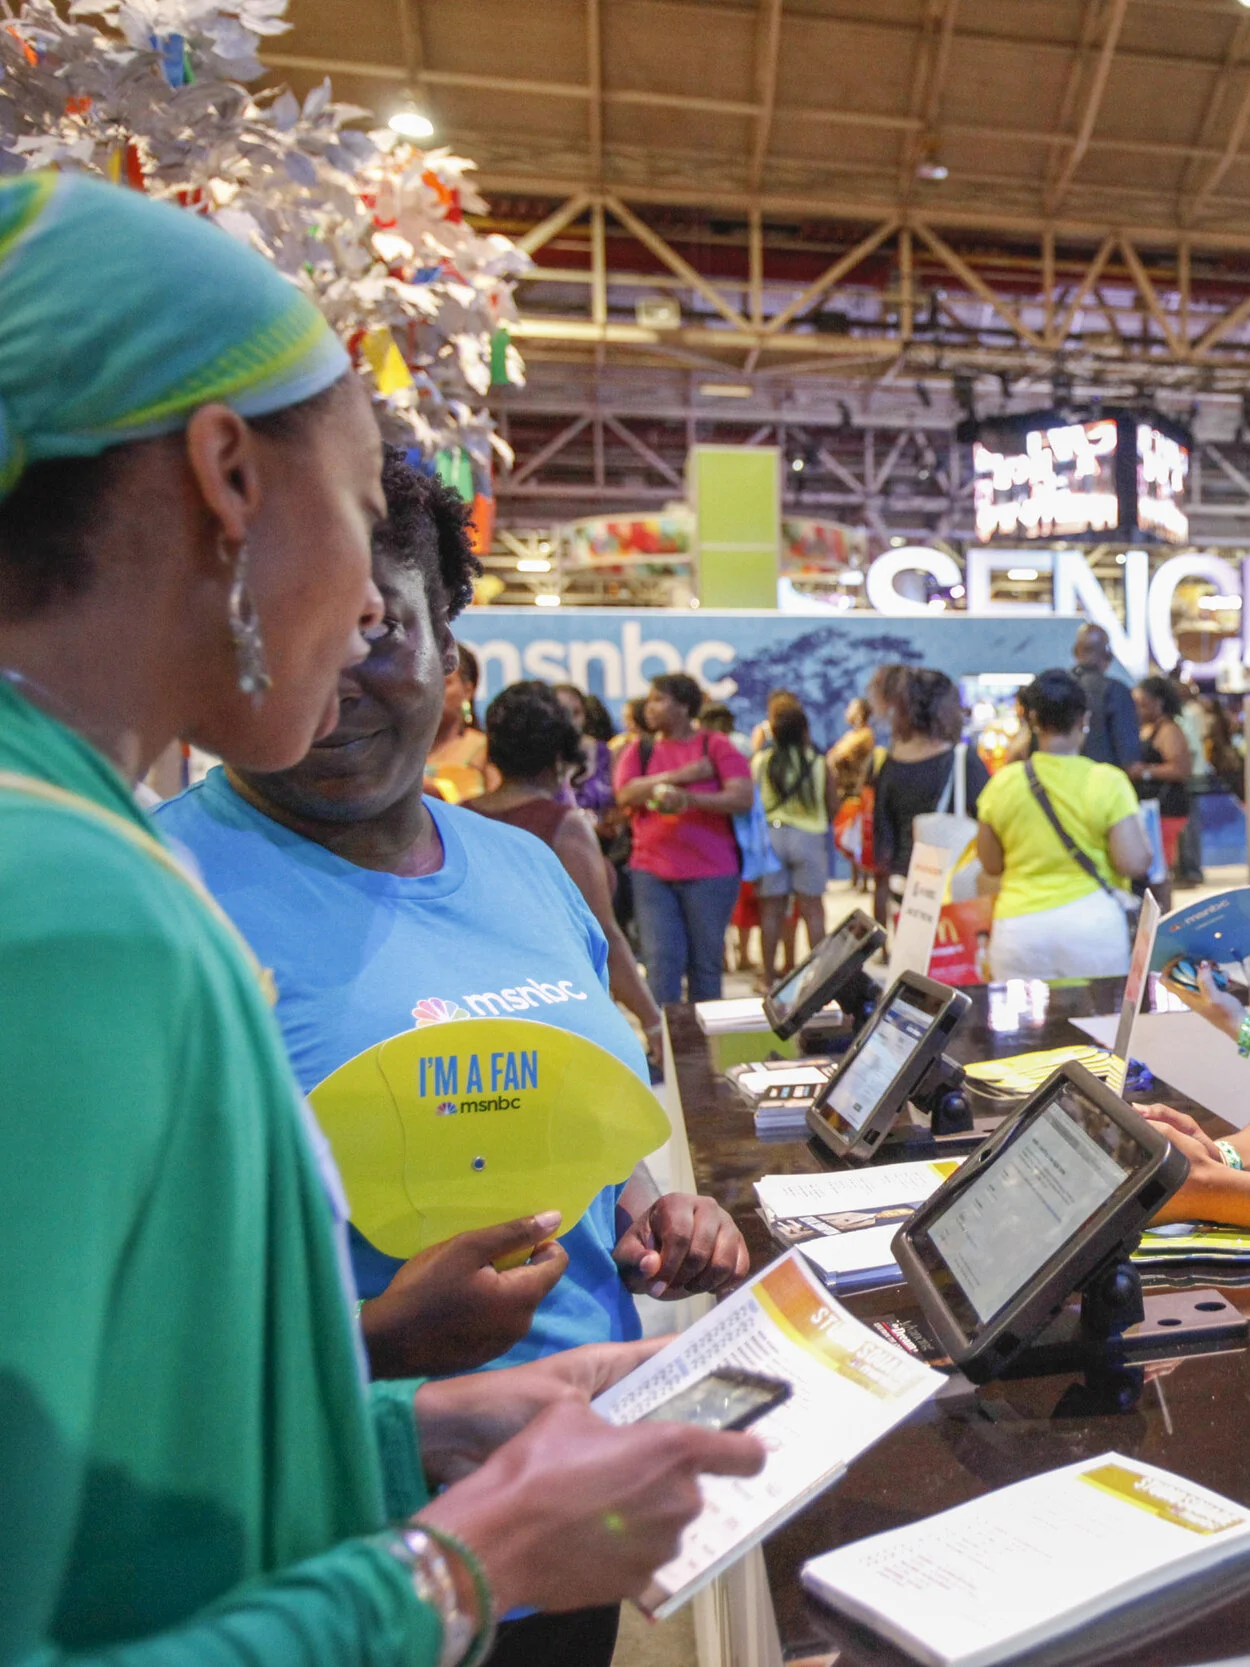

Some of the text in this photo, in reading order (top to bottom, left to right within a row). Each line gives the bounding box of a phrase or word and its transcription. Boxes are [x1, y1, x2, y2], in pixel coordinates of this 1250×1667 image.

[462, 620, 738, 700] msnbc
[463, 978, 588, 1017] msnbc
[419, 1050, 538, 1097] I'M A FAN
[460, 1096, 521, 1115] msnbc
